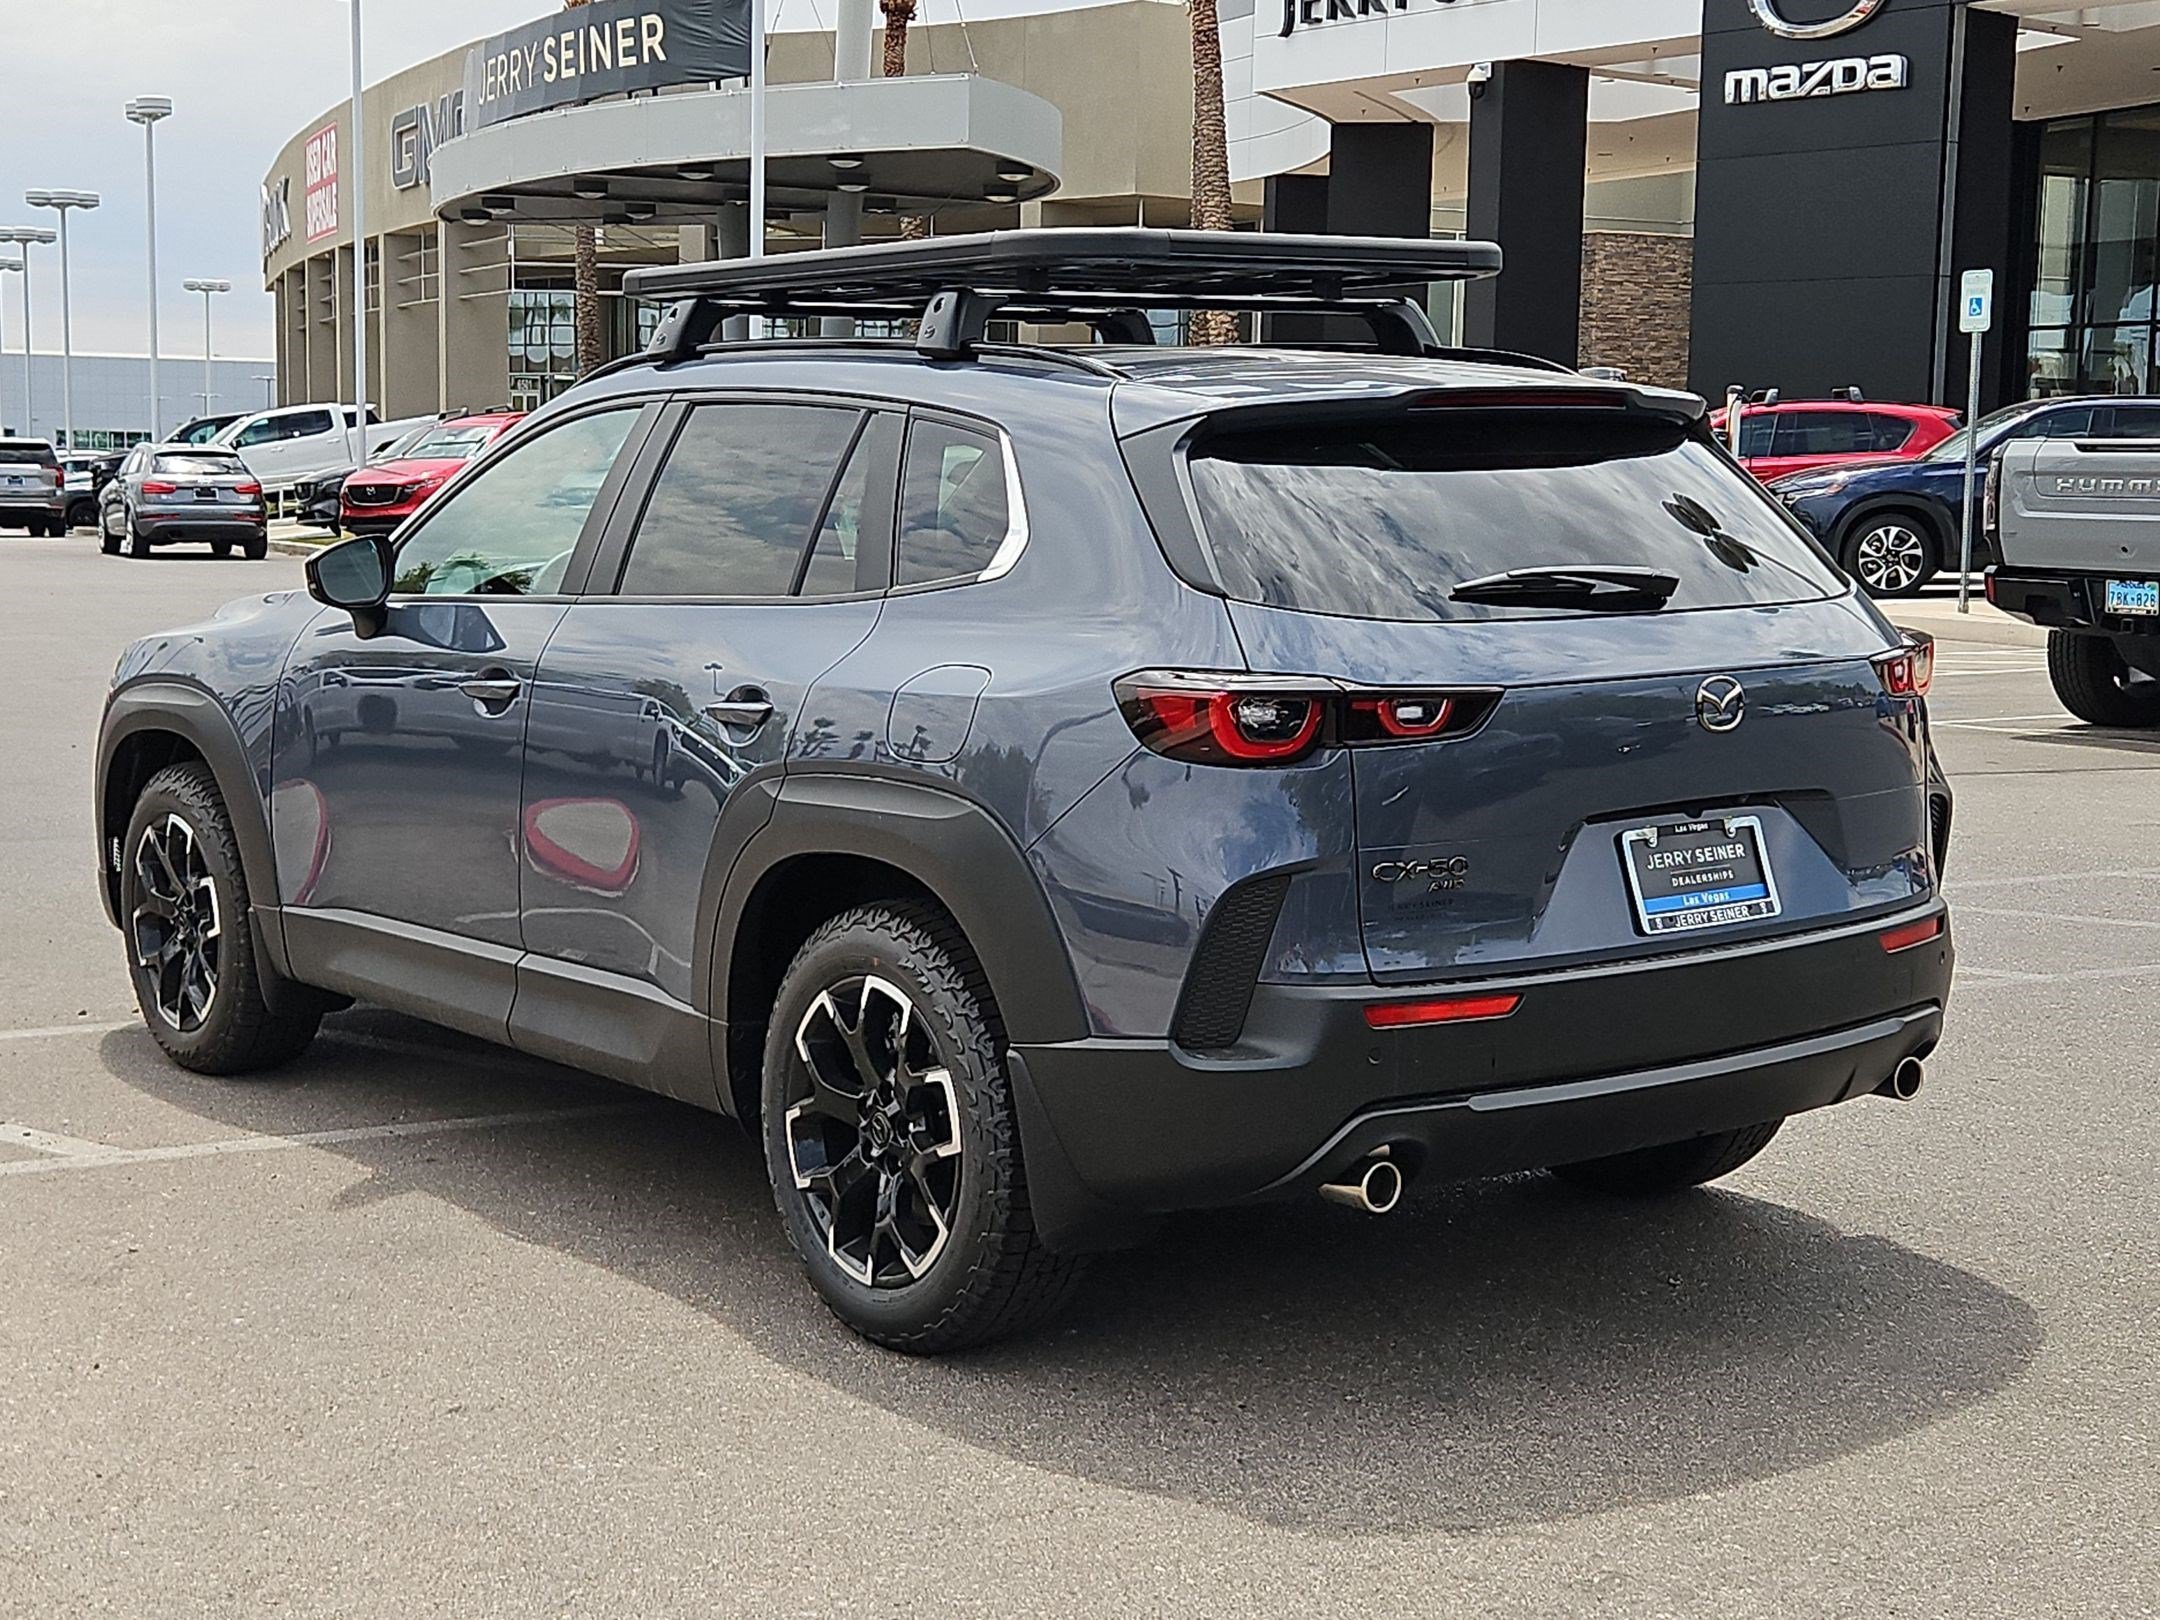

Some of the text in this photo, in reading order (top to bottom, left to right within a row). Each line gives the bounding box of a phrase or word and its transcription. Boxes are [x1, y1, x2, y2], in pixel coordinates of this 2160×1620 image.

[478, 13, 667, 105] JERRY SEINER
[2056, 477, 2160, 493] HUMM
[1674, 823, 1709, 833] Las Vegas
[1647, 843, 1746, 870] JERRY SEINER
[1372, 856, 1468, 881] CX-50
[1671, 869, 1734, 887] DEALERSHIPS
[1683, 891, 1730, 906] Las Vegas
[1675, 905, 1750, 928] JERRY SEINER
